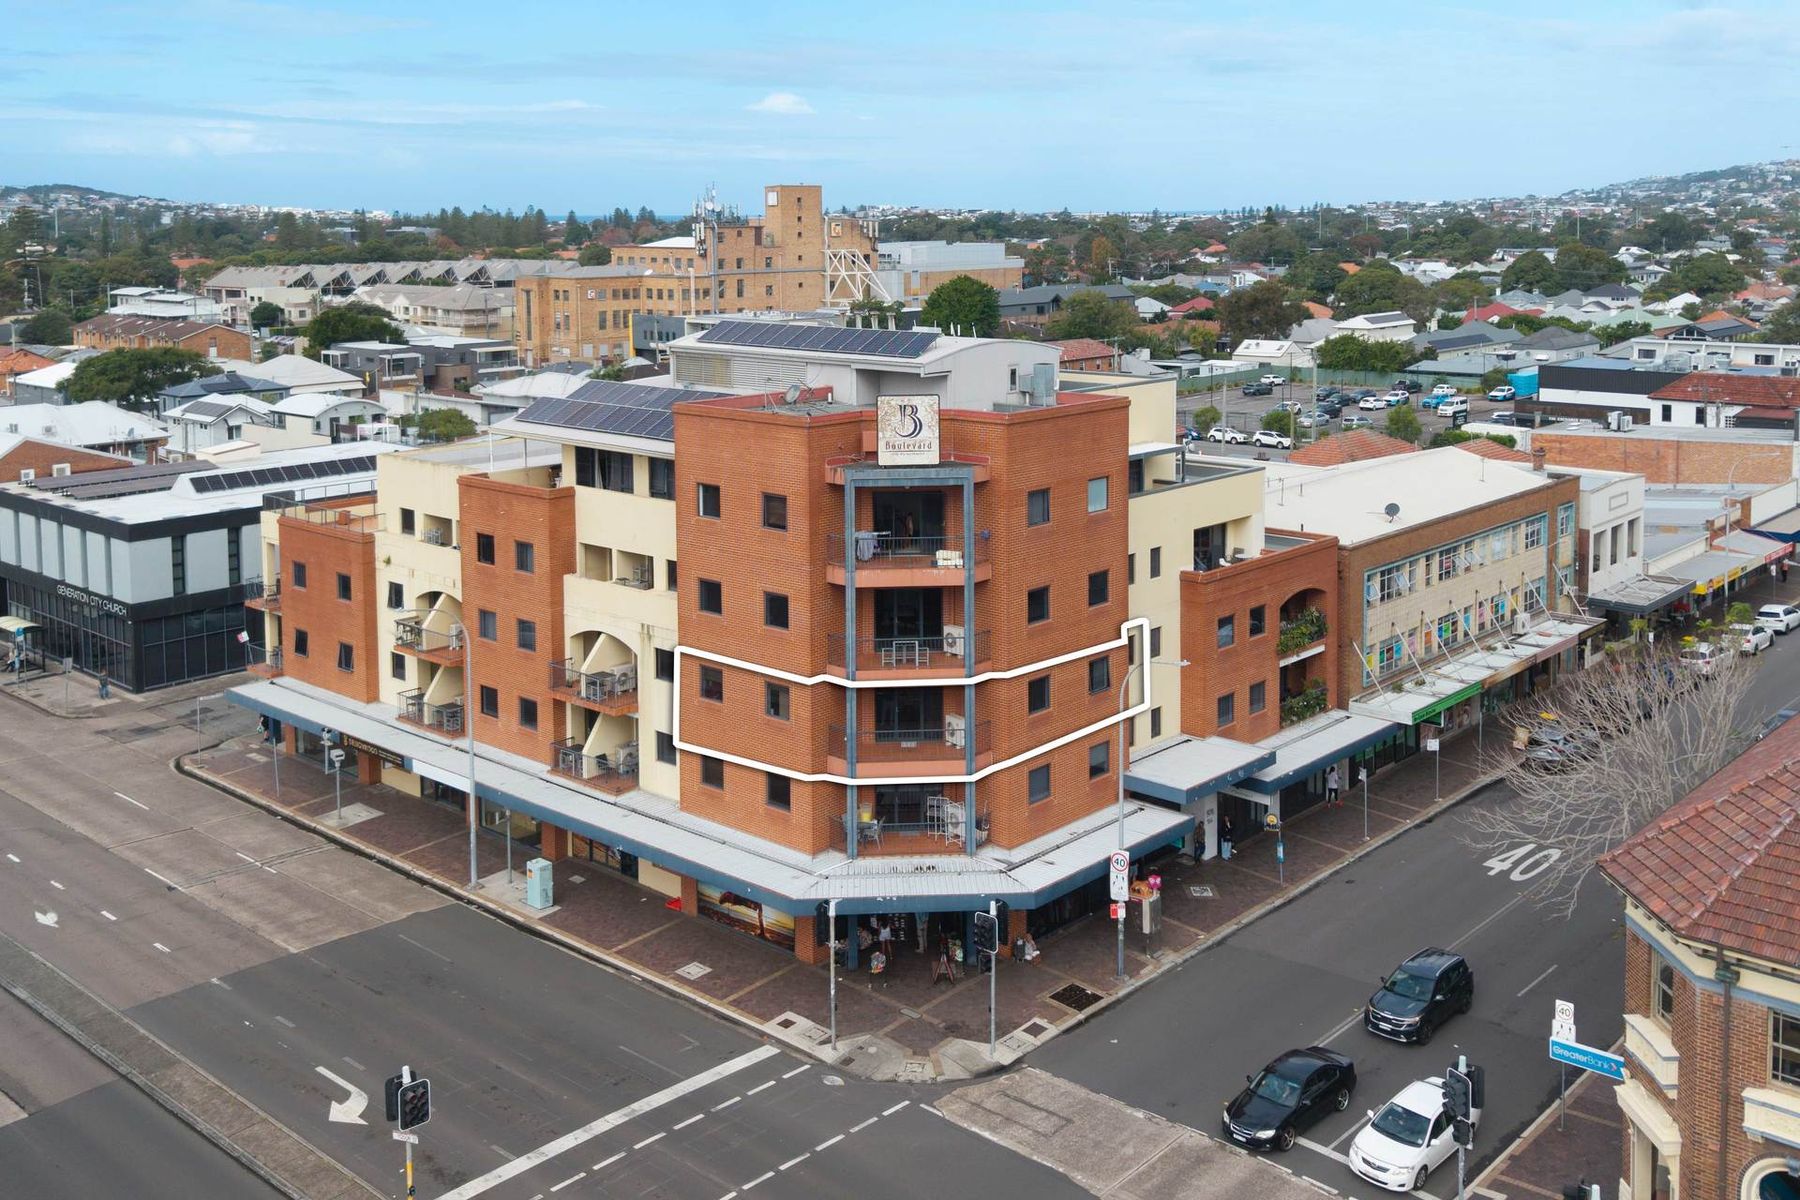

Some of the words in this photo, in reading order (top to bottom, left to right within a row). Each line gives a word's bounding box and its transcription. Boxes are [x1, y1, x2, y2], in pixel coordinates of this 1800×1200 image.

[885, 440, 932, 450] Boulevard
[56, 584, 89, 604] GENERATION
[89, 595, 103, 607] CITY
[102, 600, 127, 616] CHURCH
[1114, 857, 1126, 868] 40
[1482, 843, 1561, 881] 40
[1558, 1007, 1571, 1018] 40
[1552, 1045, 1608, 1069] GreaterBank
